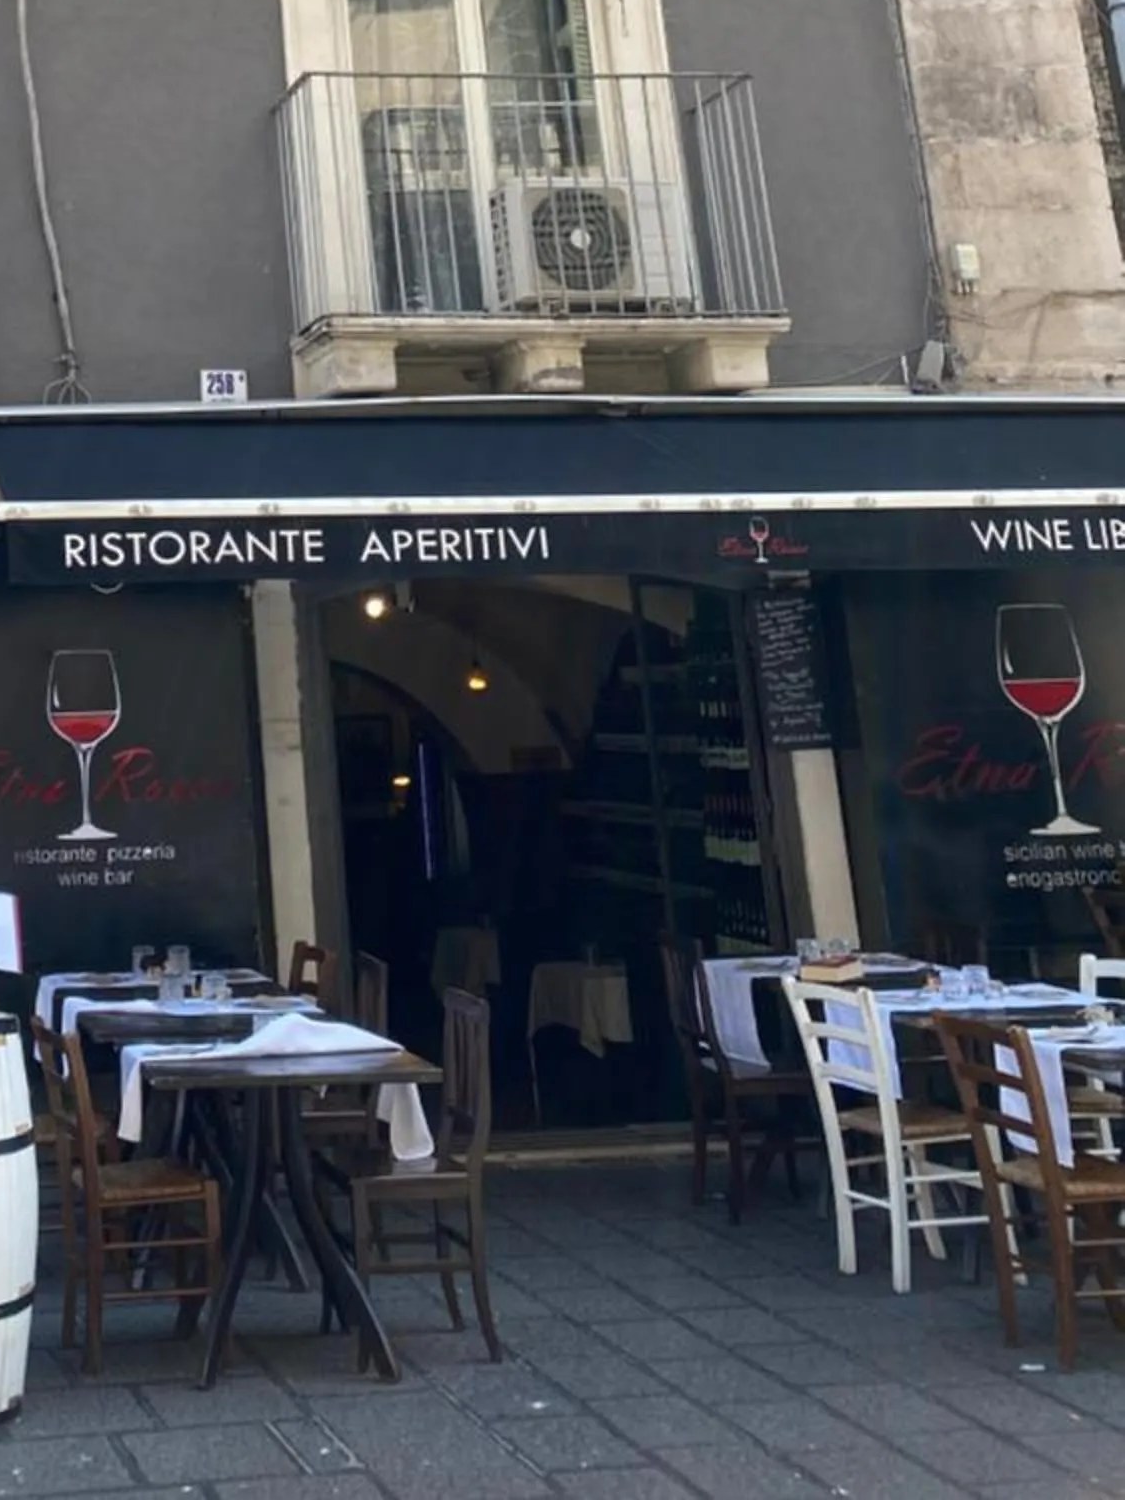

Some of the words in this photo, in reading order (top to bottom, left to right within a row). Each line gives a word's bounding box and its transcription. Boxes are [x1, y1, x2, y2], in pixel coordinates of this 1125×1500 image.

[63, 528, 324, 568] RISTORANTE
[361, 527, 550, 563] APERITIVI
[971, 518, 1073, 552] WINE
[1083, 517, 1125, 551] LIB
[57, 870, 99, 887] wine
[105, 869, 134, 886] bar
